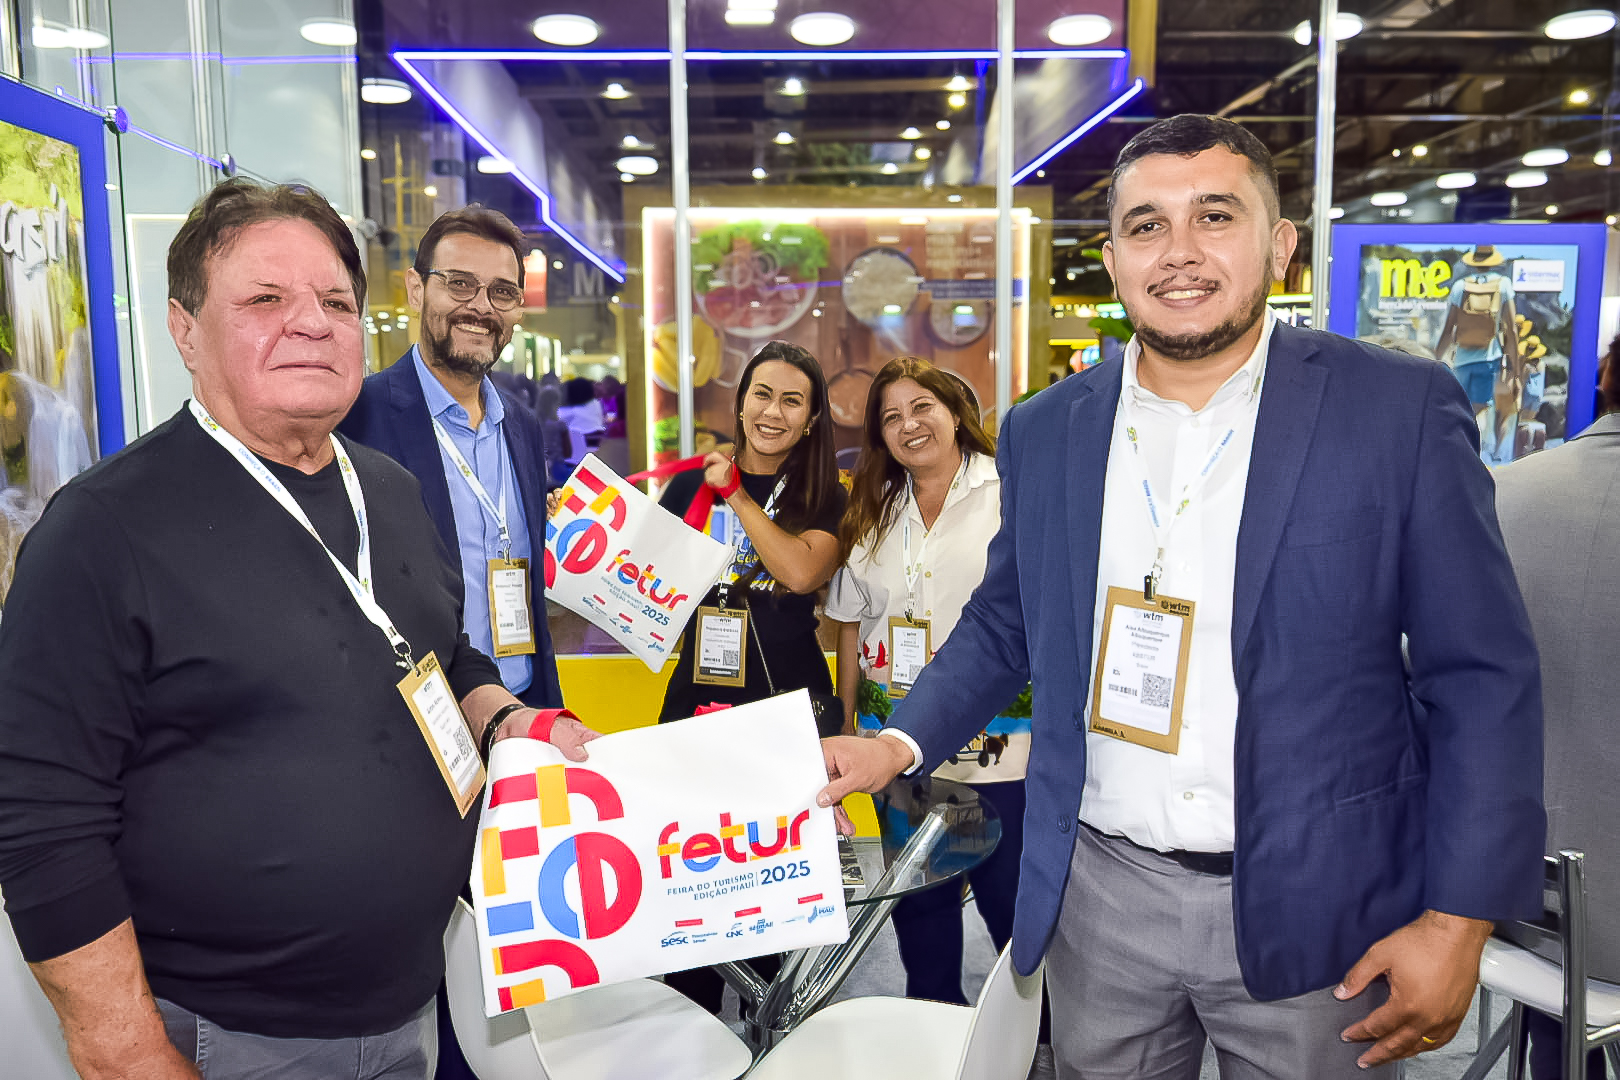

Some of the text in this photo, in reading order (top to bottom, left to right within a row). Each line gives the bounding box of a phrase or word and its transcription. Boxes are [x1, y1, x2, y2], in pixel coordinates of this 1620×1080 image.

[605, 549, 689, 611] fetur
[641, 604, 671, 626] 2025
[1143, 612, 1164, 622] wtm
[657, 808, 810, 879] fetur
[667, 872, 754, 896] FEIRA DO TURISMO
[760, 860, 811, 885] 2025
[693, 880, 755, 901] EDIÇÃO PIAUÍ
[726, 930, 744, 938] CNC
